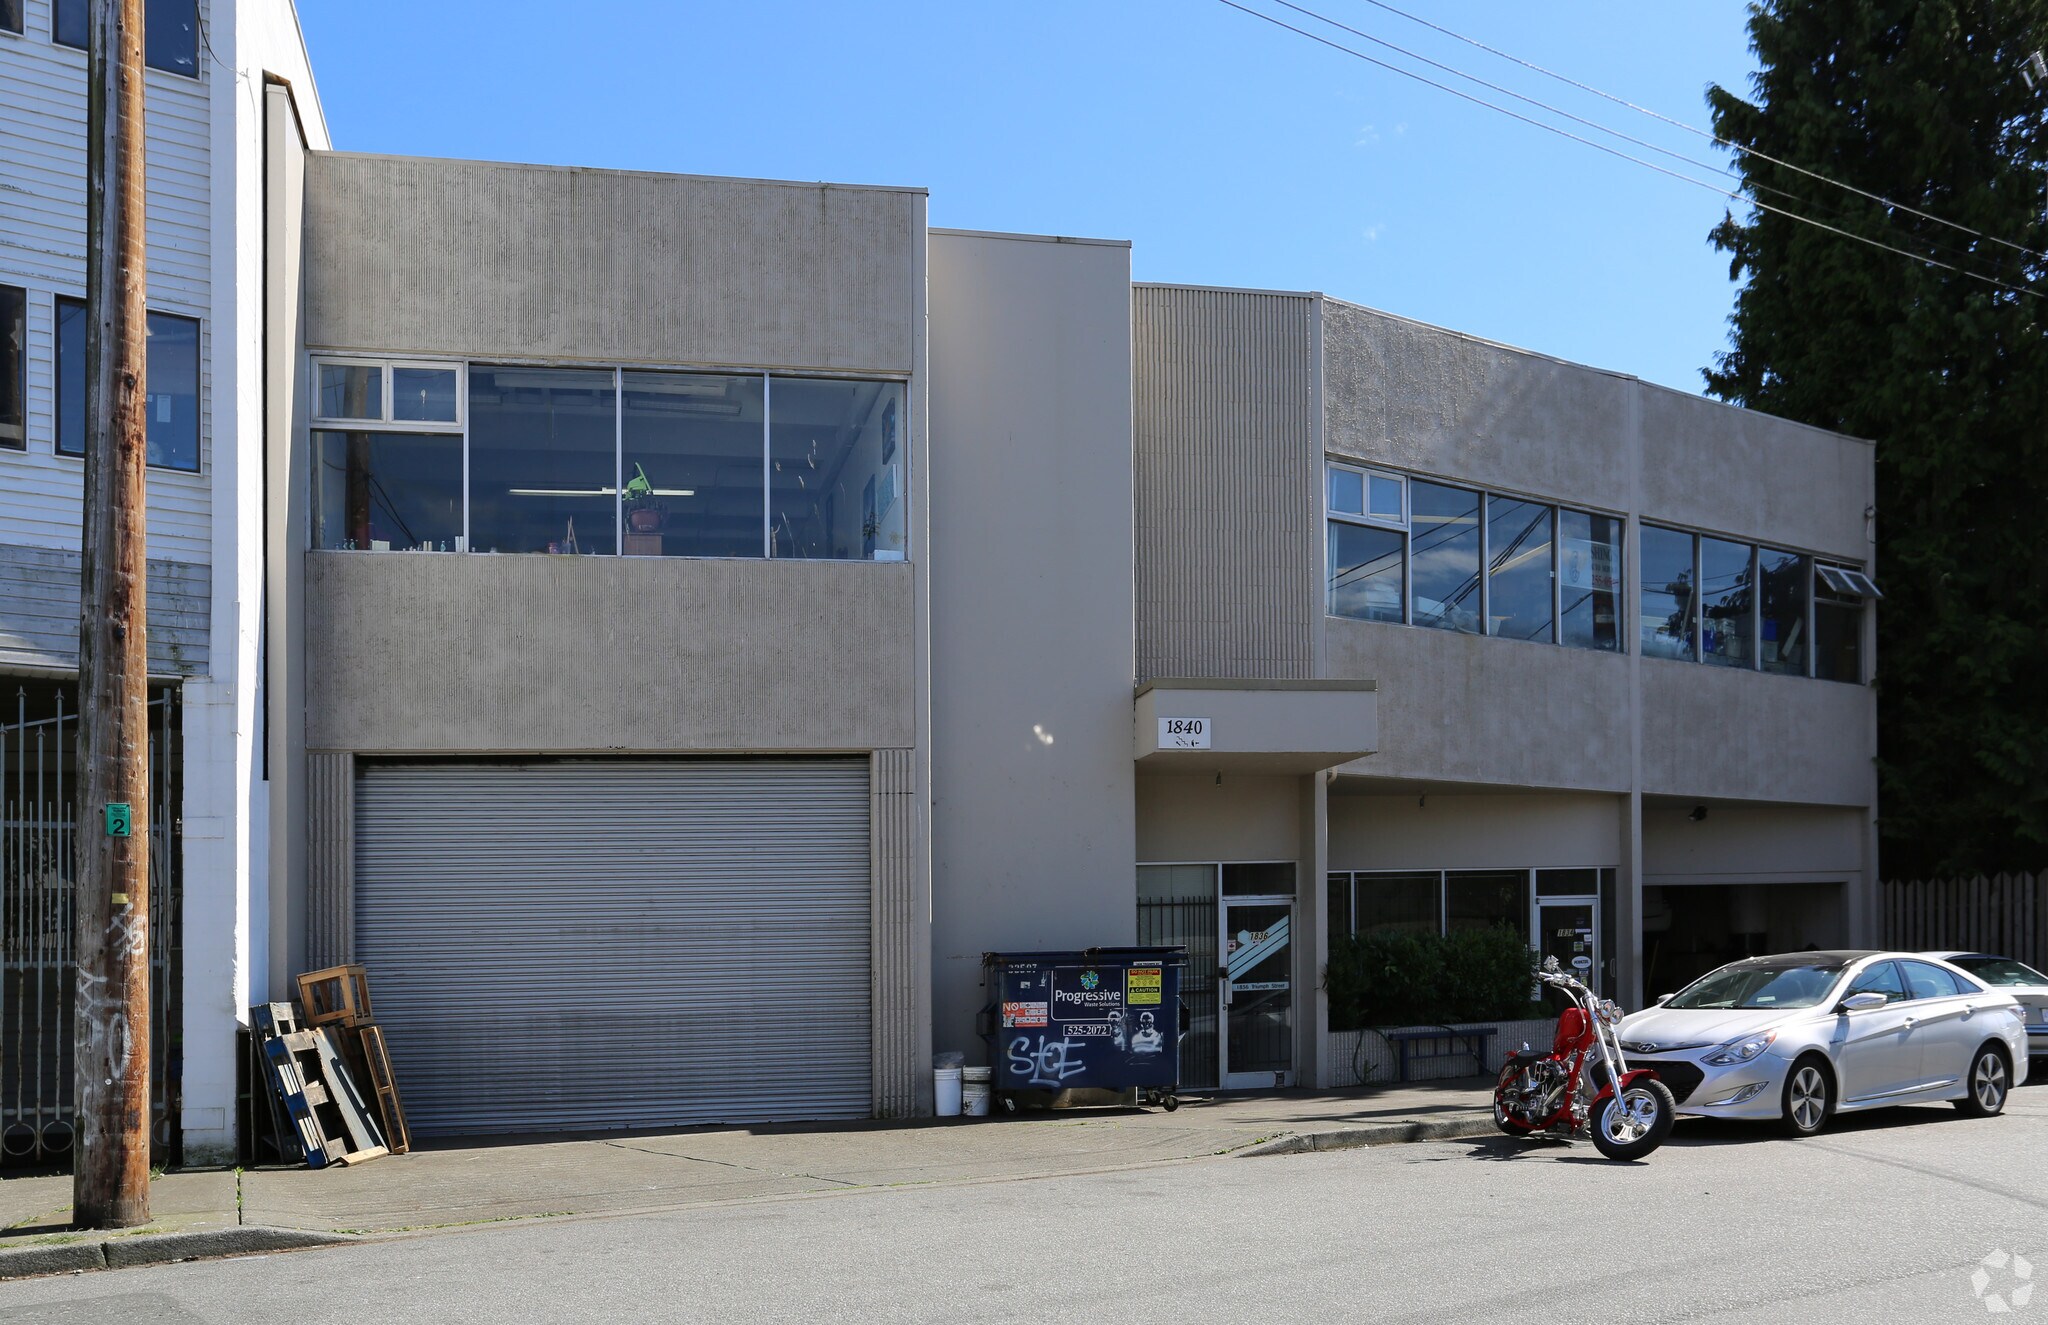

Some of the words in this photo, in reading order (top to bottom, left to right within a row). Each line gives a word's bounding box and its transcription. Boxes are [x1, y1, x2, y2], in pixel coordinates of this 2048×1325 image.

[1167, 720, 1202, 735] 1840
[113, 819, 125, 834] 2
[1250, 932, 1269, 940] 1836
[1055, 989, 1121, 1005] Progressive
[1067, 1026, 1107, 1035] 525-2072
